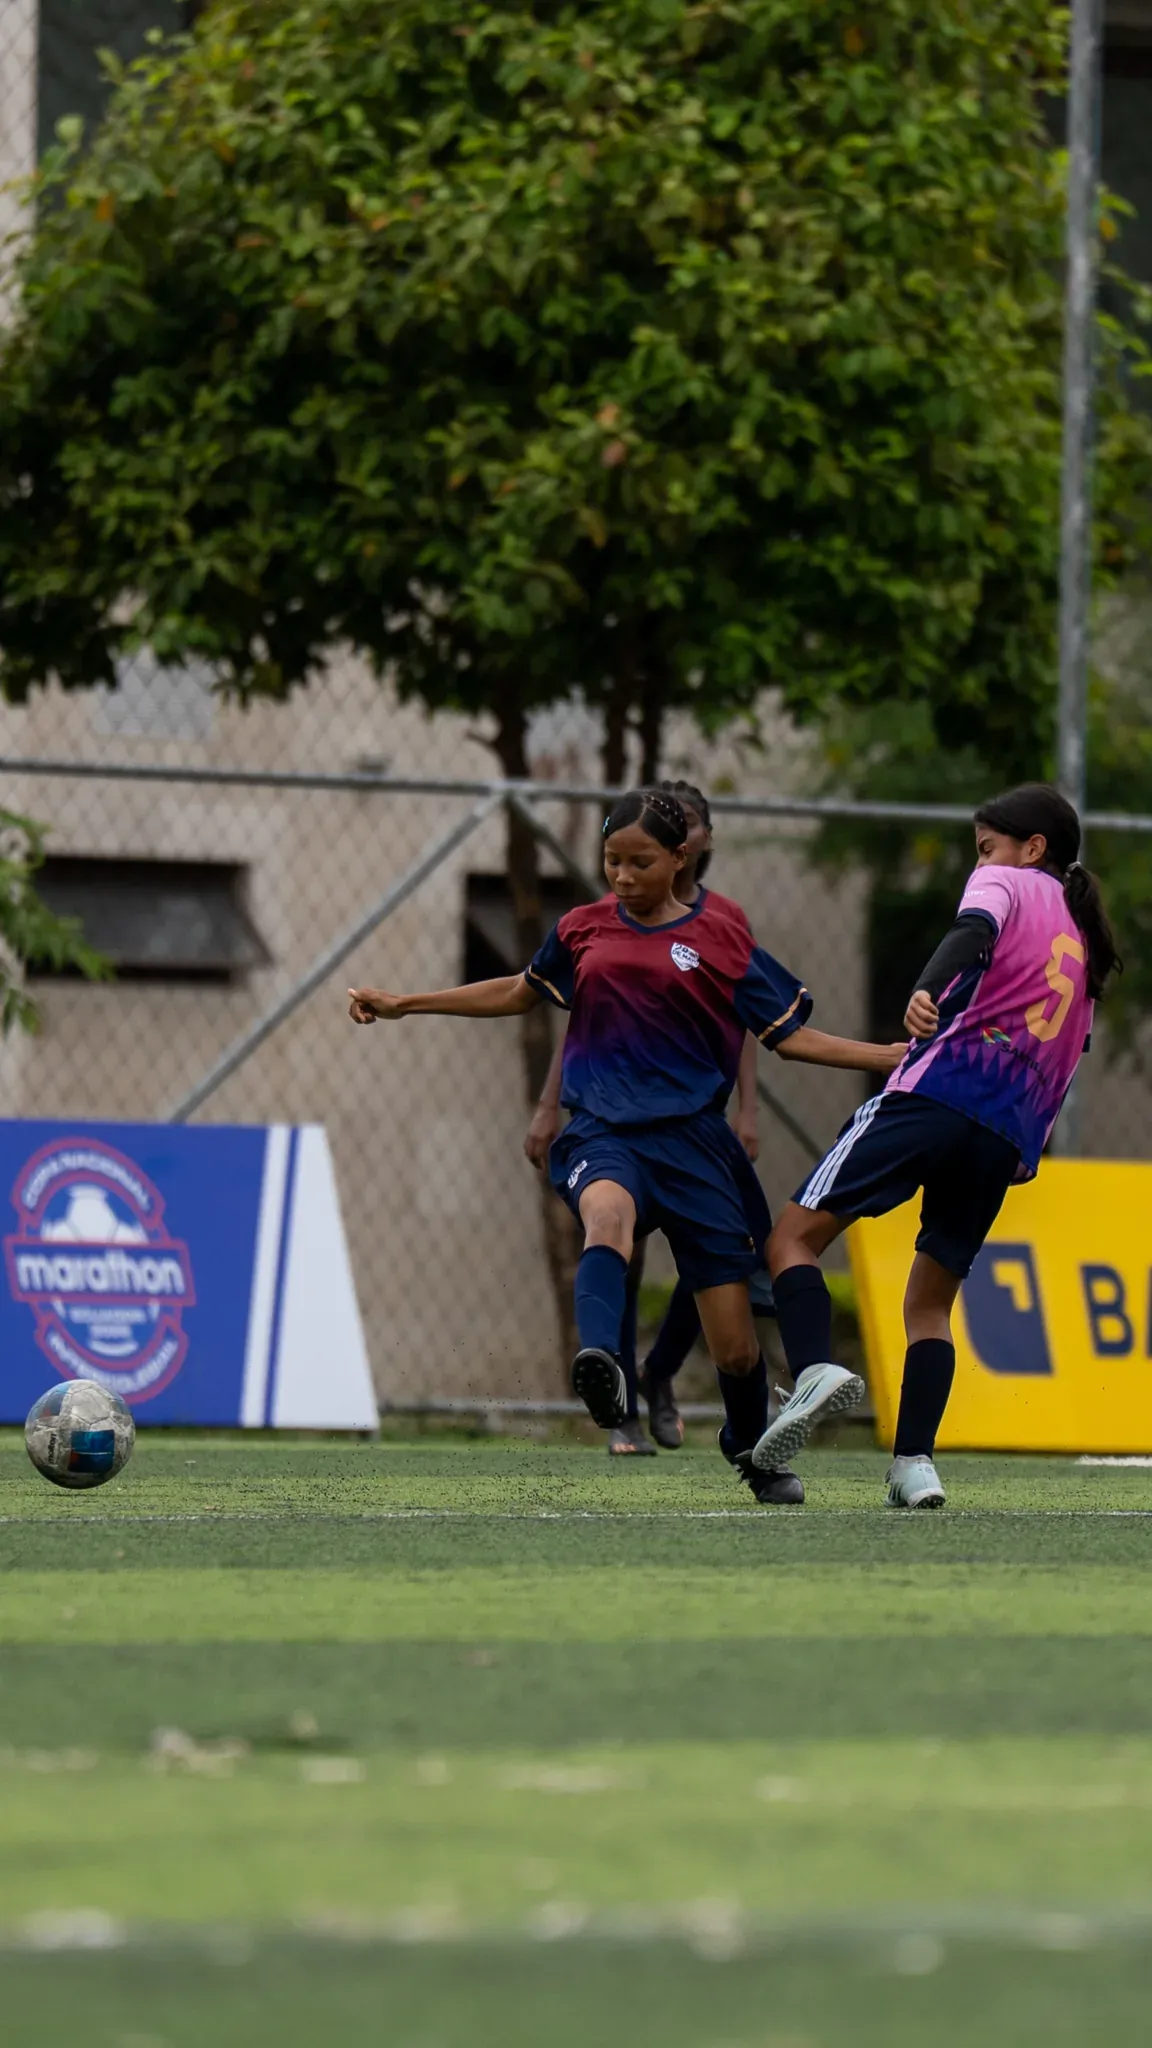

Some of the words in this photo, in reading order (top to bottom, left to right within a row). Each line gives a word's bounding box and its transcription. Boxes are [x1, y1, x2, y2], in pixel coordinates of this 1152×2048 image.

[1024, 932, 1085, 1042] 5
[16, 1247, 186, 1296] marathon
[1080, 1263, 1152, 1358] B
